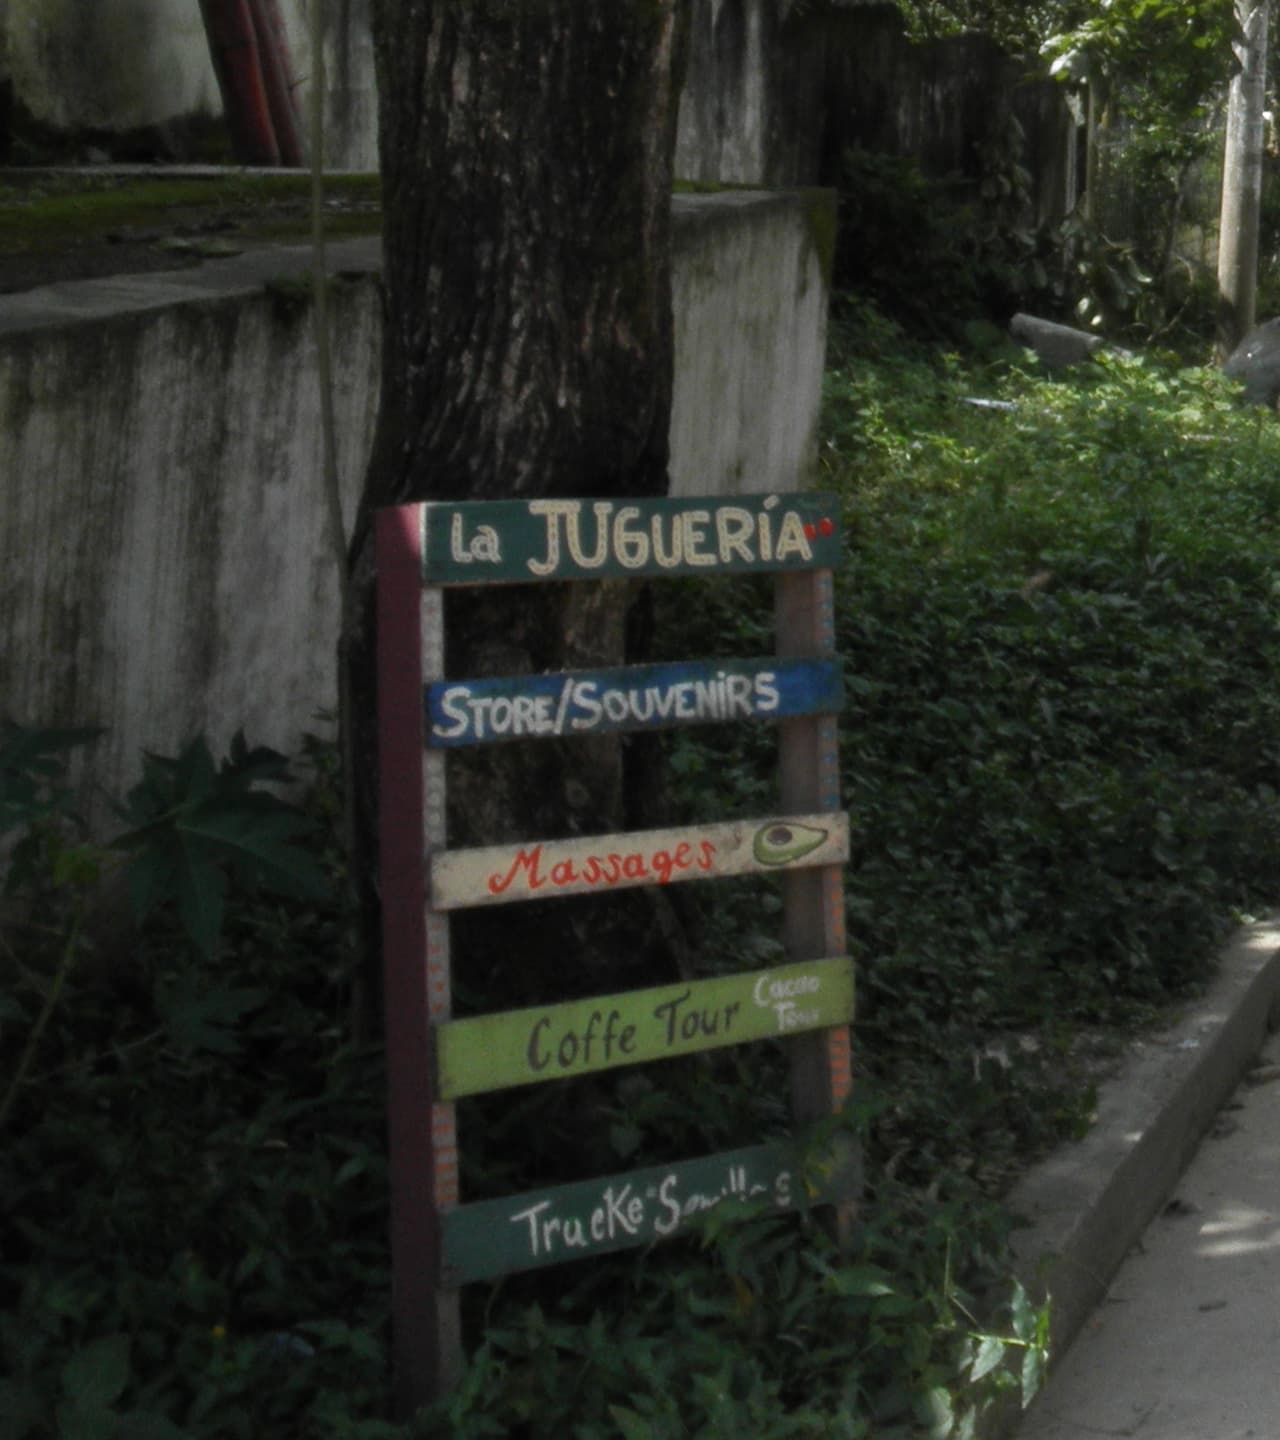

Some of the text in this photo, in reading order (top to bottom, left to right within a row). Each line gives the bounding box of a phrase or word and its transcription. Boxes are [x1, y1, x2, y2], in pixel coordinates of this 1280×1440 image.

[451, 494, 813, 576] La JUGUERÍA
[488, 841, 717, 895] Massages
[526, 988, 740, 1072] Coffe Tour
